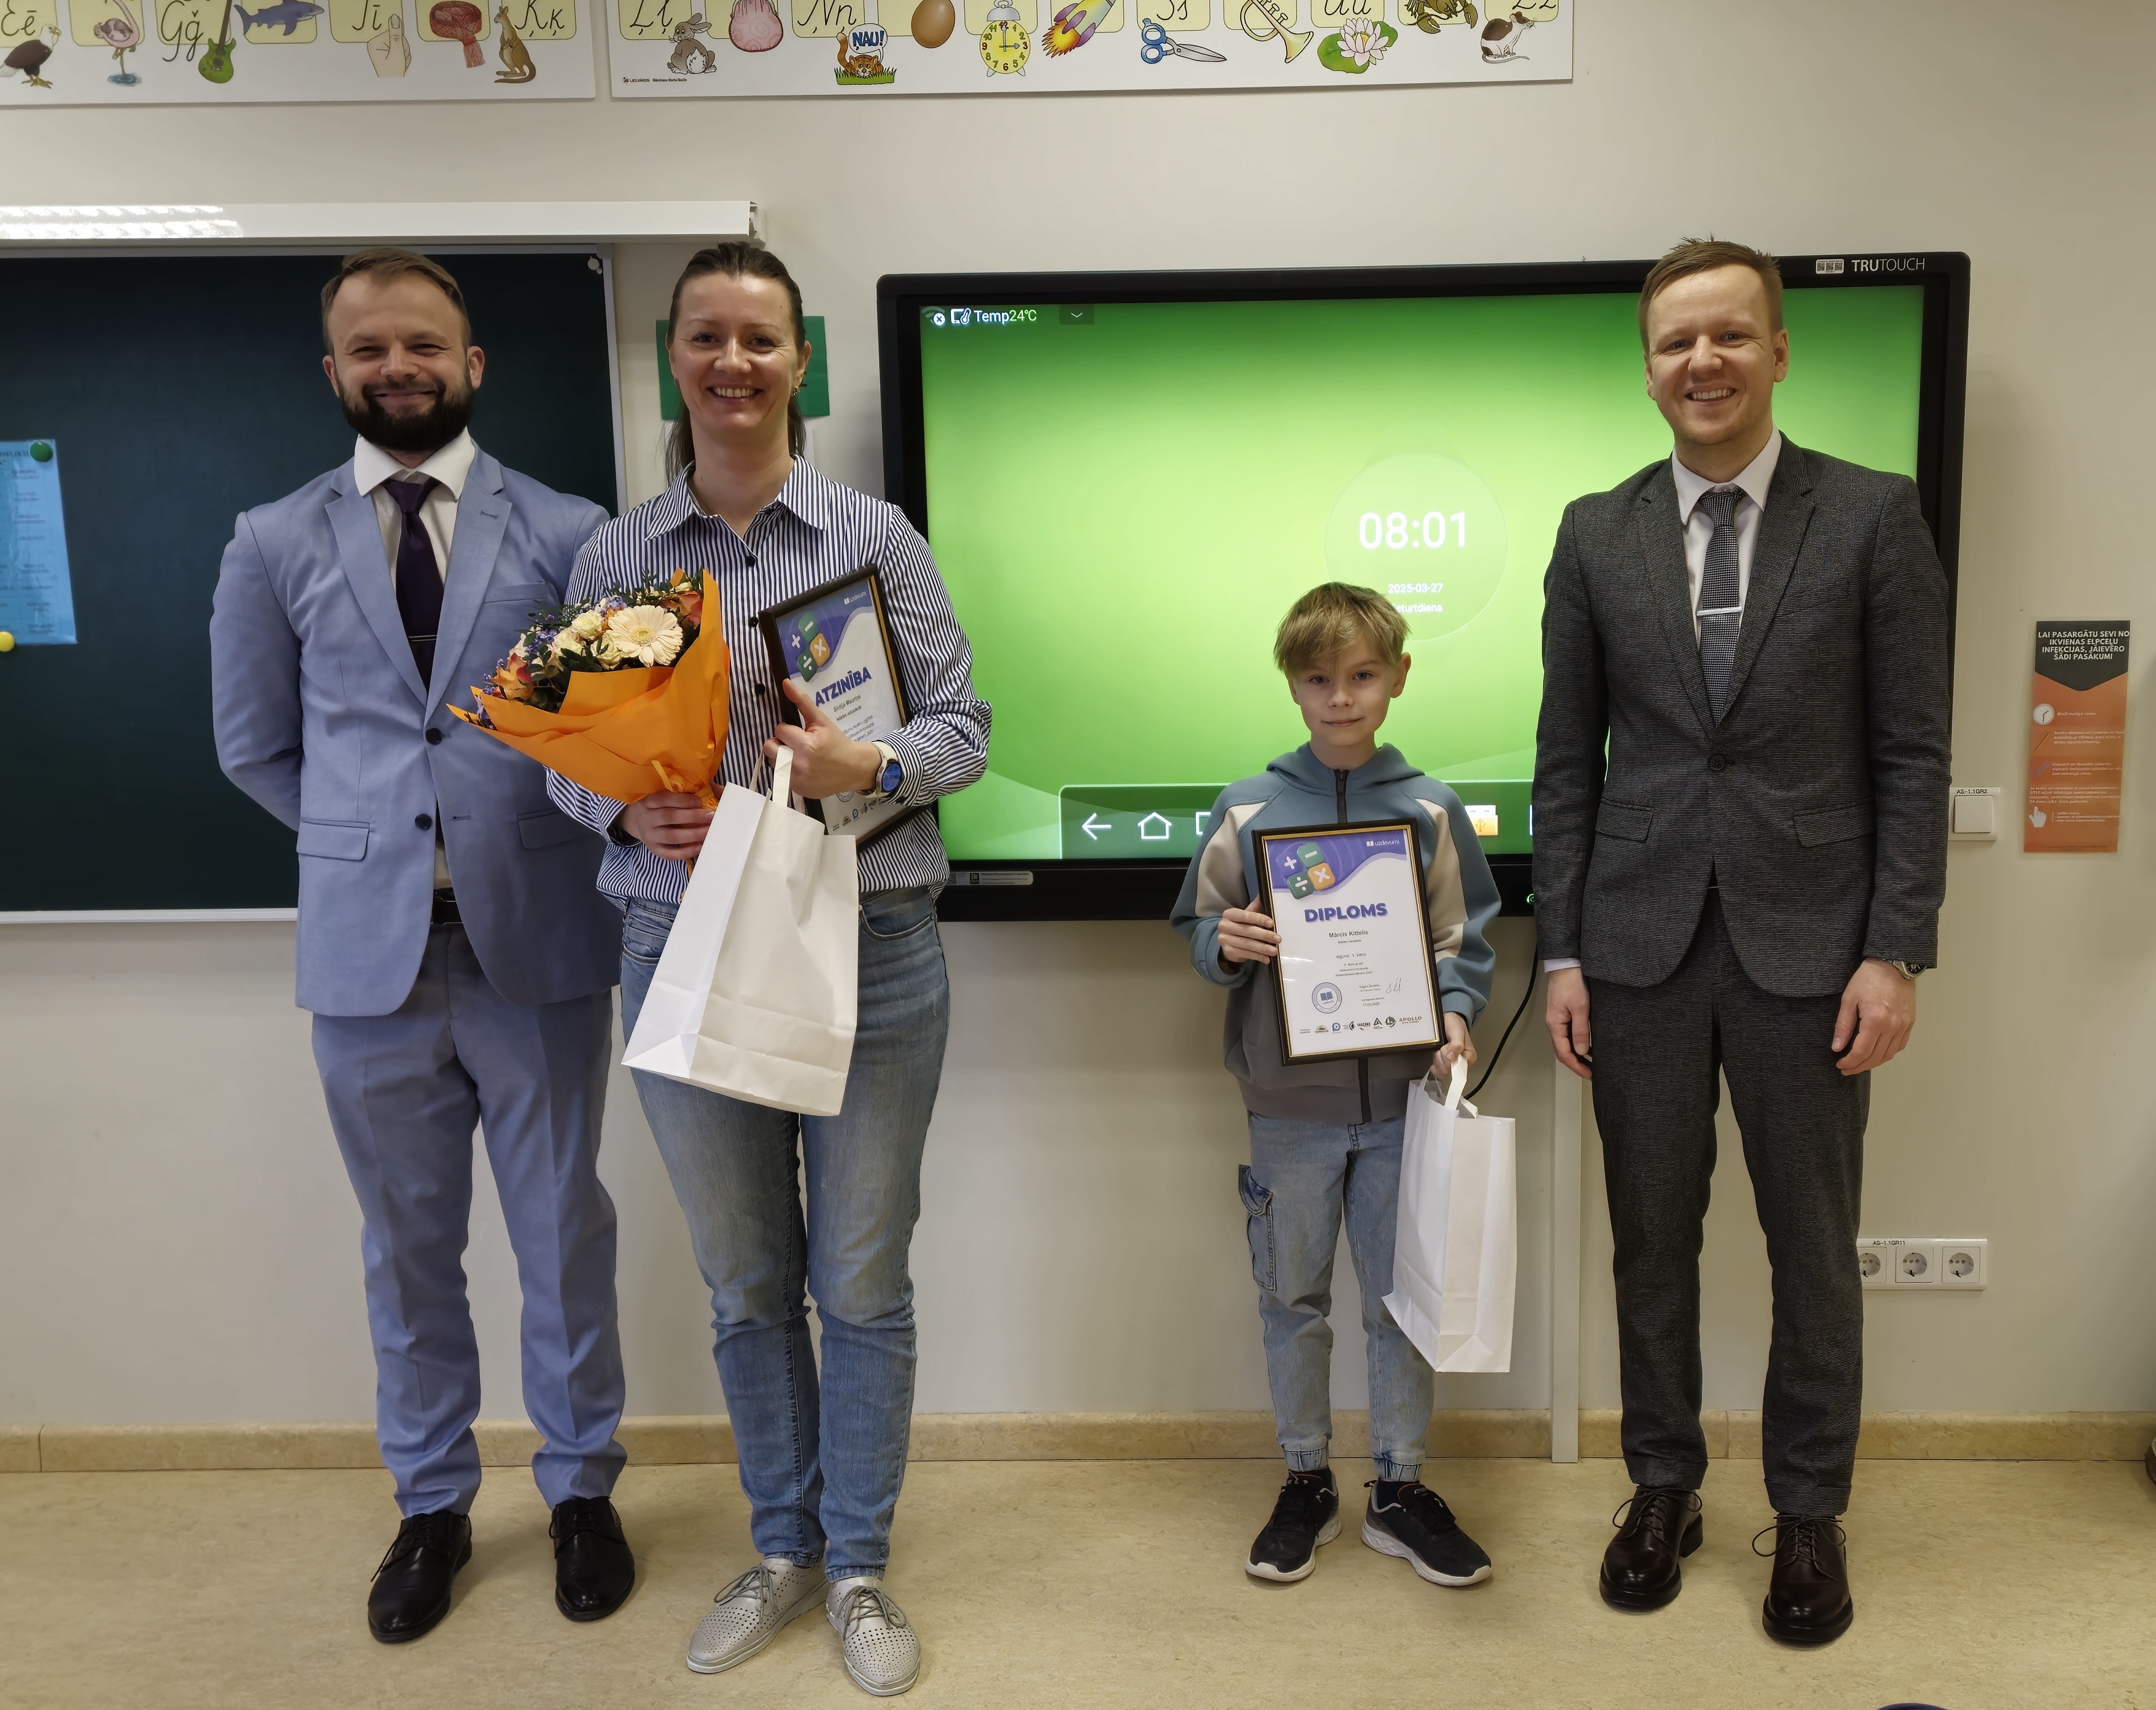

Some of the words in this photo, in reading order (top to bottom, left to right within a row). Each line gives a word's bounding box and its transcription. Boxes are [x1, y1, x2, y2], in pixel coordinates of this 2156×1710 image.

[852, 30, 885, 50] ŅAU!
[1019, 31, 1025, 40] 2
[1019, 52, 1025, 60] 4
[1013, 59, 1018, 68] 5
[1852, 258, 1925, 272] TRUTOUCH
[1359, 511, 1465, 549] 08:01
[1388, 583, 1443, 593] 2025-03-27
[1392, 603, 1443, 612] eturtdiena
[2054, 651, 2071, 660] ŠĀDI
[816, 667, 872, 707] ATZINĪBA
[1304, 903, 1388, 922] DIPLOMS
